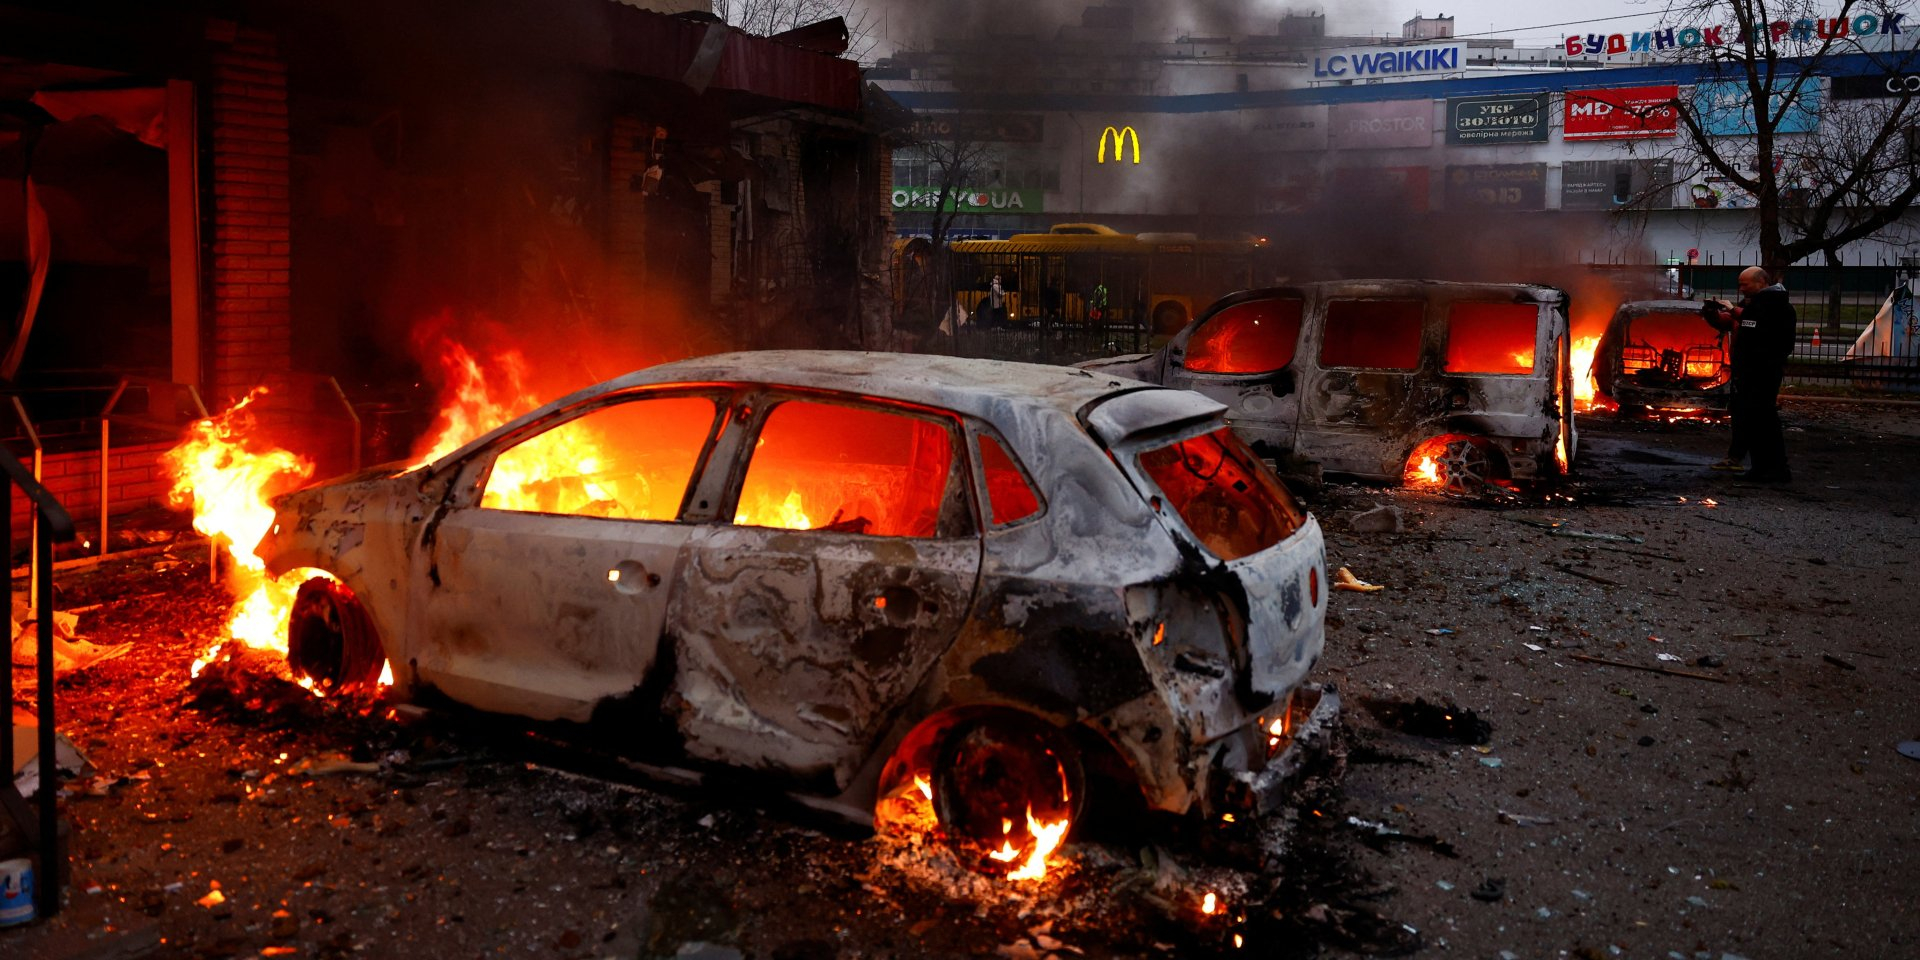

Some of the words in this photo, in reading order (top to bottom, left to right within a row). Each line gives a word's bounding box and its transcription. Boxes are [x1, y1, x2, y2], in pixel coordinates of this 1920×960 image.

[1564, 24, 1725, 57] БУДИНОК
[1314, 55, 1347, 77] LC
[1480, 104, 1515, 115] УКР
[1570, 102, 1614, 116] MD
[1349, 117, 1425, 133] PROSTOR
[1460, 115, 1535, 127] ЗОЛОТО
[1459, 131, 1499, 139] ювелірна
[1701, 161, 1741, 171] brin
